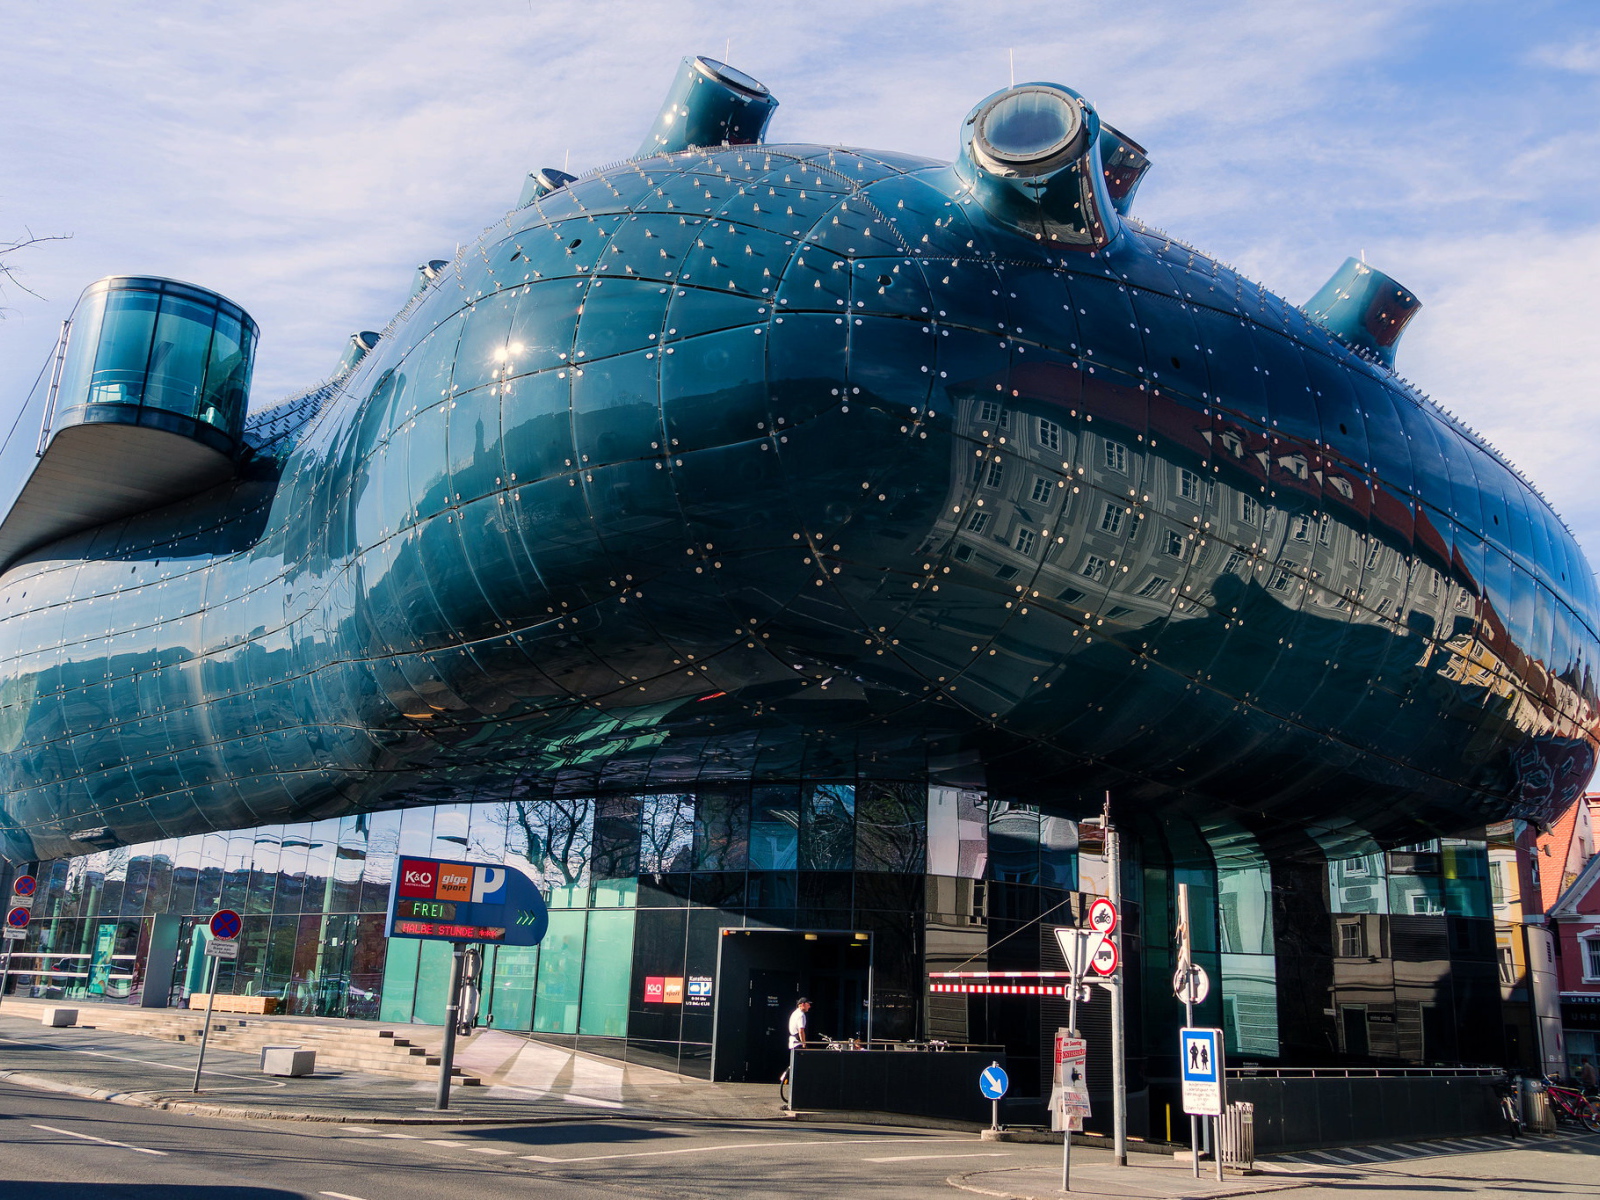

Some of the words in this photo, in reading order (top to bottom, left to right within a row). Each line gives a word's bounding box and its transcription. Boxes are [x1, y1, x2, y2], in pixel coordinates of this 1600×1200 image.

[441, 874, 468, 885] giga
[471, 866, 506, 903] P
[413, 903, 443, 917] FREI
[402, 923, 433, 934] HALBE
[438, 926, 474, 937] STUNDE
